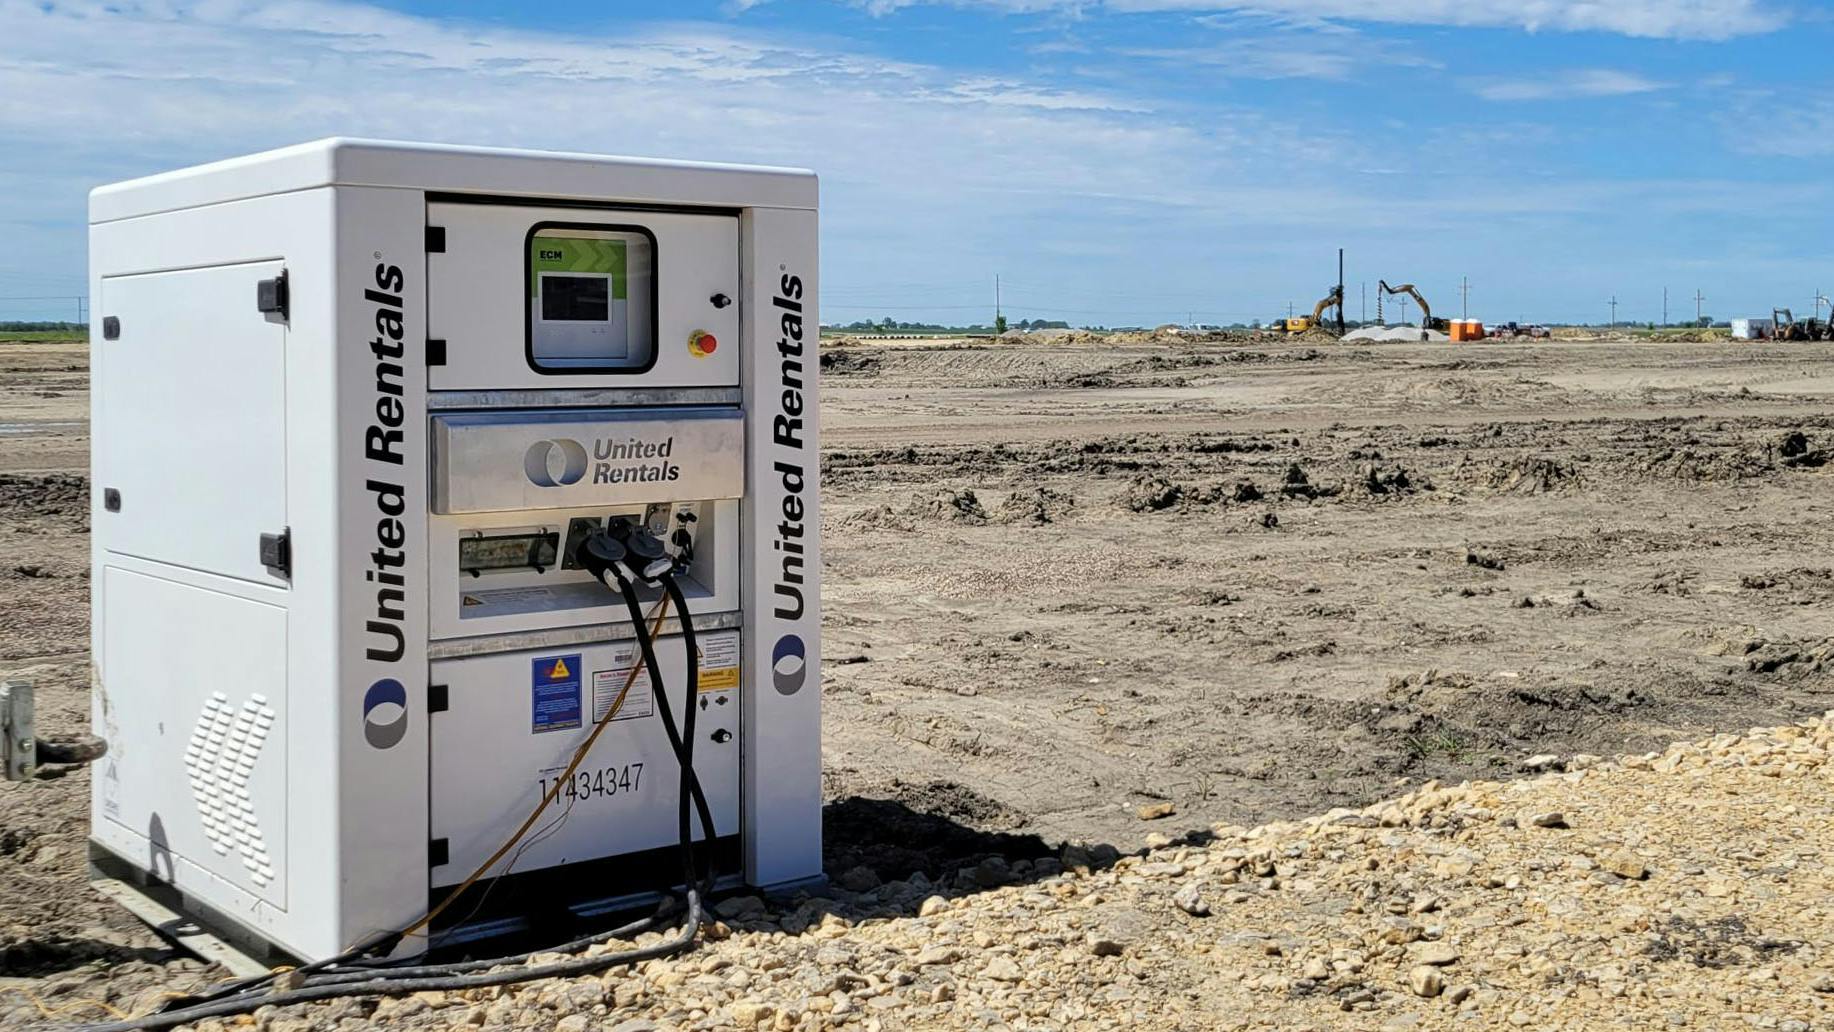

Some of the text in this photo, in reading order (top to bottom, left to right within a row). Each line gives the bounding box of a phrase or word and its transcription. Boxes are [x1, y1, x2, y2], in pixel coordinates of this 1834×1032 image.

[540, 250, 562, 260] ECM
[365, 263, 405, 662] United Rentals
[594, 437, 673, 460] United
[773, 273, 804, 621] United Rentals
[594, 461, 680, 484] Rentals
[539, 763, 643, 804] 11434347
